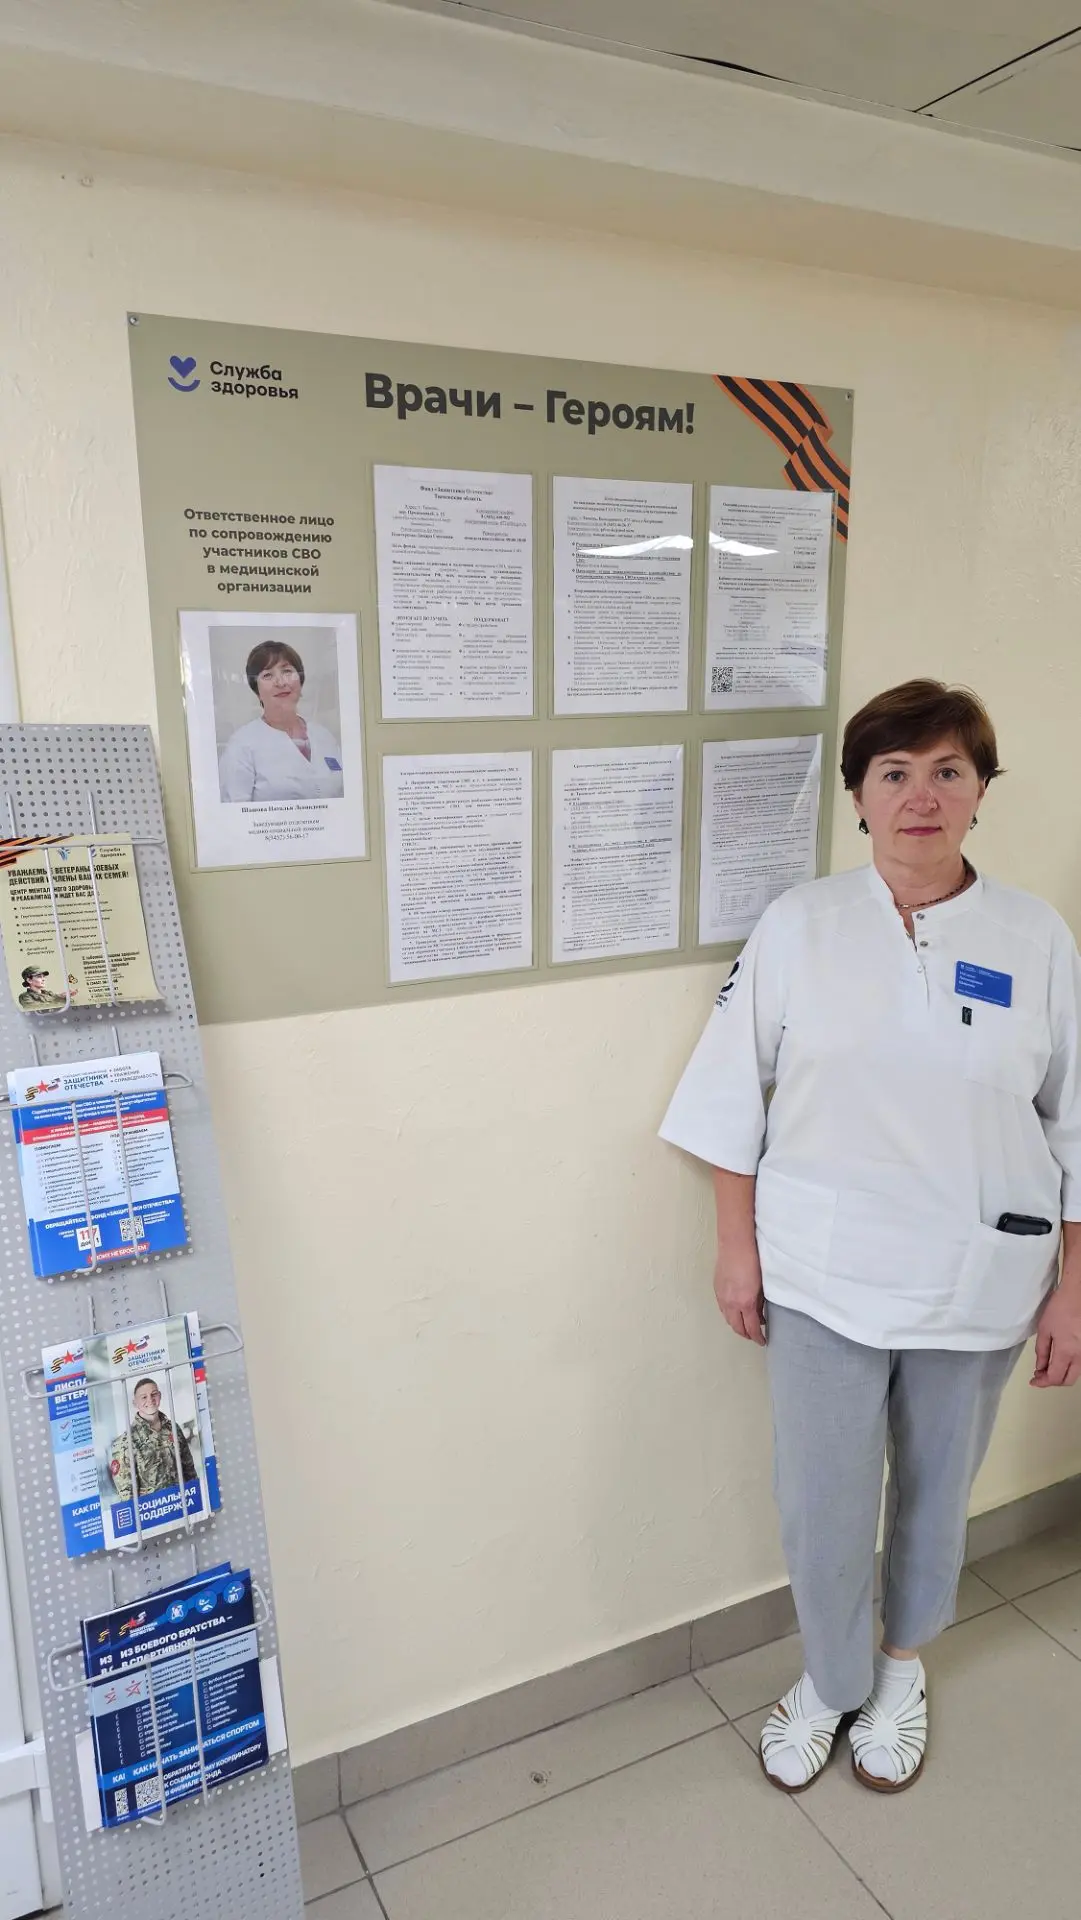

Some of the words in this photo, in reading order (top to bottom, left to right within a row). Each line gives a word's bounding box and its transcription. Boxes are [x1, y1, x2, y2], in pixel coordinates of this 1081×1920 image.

[209, 360, 283, 381] Служба
[211, 381, 299, 399] здоровья
[365, 372, 501, 420] Врачи
[546, 390, 695, 435] Героям!
[184, 508, 295, 524] Ответственное
[299, 515, 335, 526] лицо
[189, 527, 207, 538] по
[211, 528, 332, 543] сопровождению
[202, 546, 288, 560] участников
[292, 548, 321, 559] СВО
[207, 564, 216, 573] в
[220, 564, 319, 577] медицинской
[217, 582, 312, 594] организации
[9, 876, 45, 886] ДЕЙСТВИЙ
[104, 871, 129, 880] СЕМЕЙ!
[10, 888, 27, 896] ЦЕНТР
[28, 886, 67, 894] МЕНТАЛНОГО
[63, 1074, 109, 1085] ЗАЩИТНИКИ
[64, 1080, 105, 1091] ОТЕЧЕСТВА
[110, 1128, 148, 1138] ПОДЕРЖИВАЕМ
[45, 1216, 86, 1229] ОБРАЩАЙТЕСЬ
[107, 1204, 143, 1216] «ЗАЩИТИКИ
[119, 1245, 147, 1256] БРОСЕМ
[128, 1349, 165, 1361] ЗАЩИТНИКИ
[128, 1355, 162, 1367] ОТЕЧЕСТВА
[72, 1507, 89, 1517] КАК
[140, 1498, 194, 1522] ПОДДЕРЖА
[120, 1647, 133, 1659] ИЗ
[134, 1632, 178, 1653] БОЕВОГО
[179, 1616, 226, 1637] БРАТСТВА
[99, 1654, 113, 1666] ИЗ
[133, 1765, 150, 1777] КАК
[150, 1753, 178, 1769] НААТЬ
[178, 1734, 226, 1758] ЗАНИАТЬСЯ
[226, 1719, 260, 1738] СПОРТОМ
[163, 1760, 201, 1781] ОБРАТИТЬСЯ
[164, 1781, 170, 1789] К
[169, 1763, 216, 1786] СОЦИАЛЬОМУ
[216, 1742, 262, 1768] КООРДИНАТОРУ
